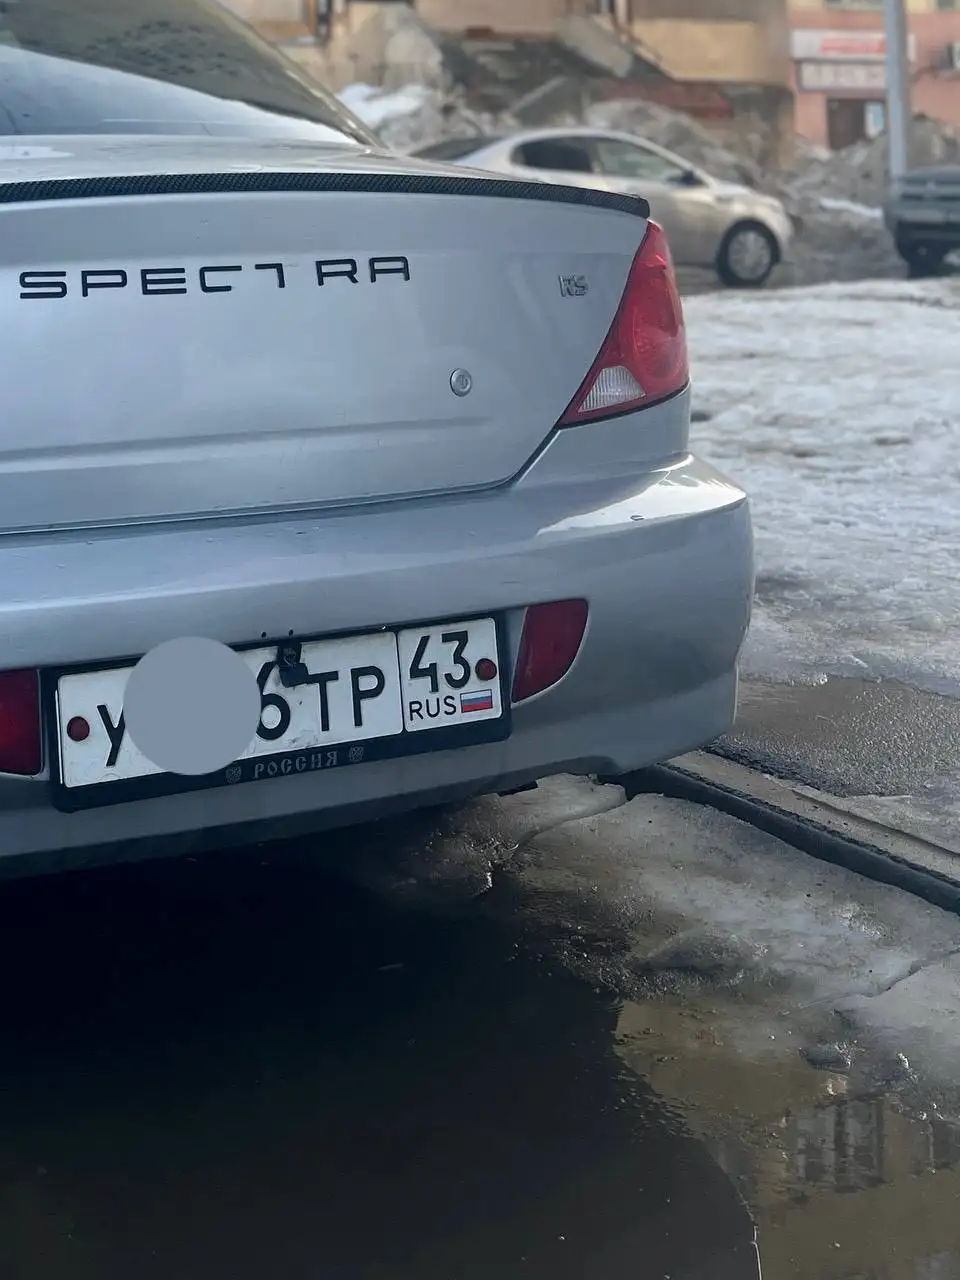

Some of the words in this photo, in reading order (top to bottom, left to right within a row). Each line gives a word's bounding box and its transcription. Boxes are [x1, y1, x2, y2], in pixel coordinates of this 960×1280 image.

[409, 630, 472, 694] 43
[408, 695, 457, 722] RUS
[253, 750, 338, 779] РОССИЯ
